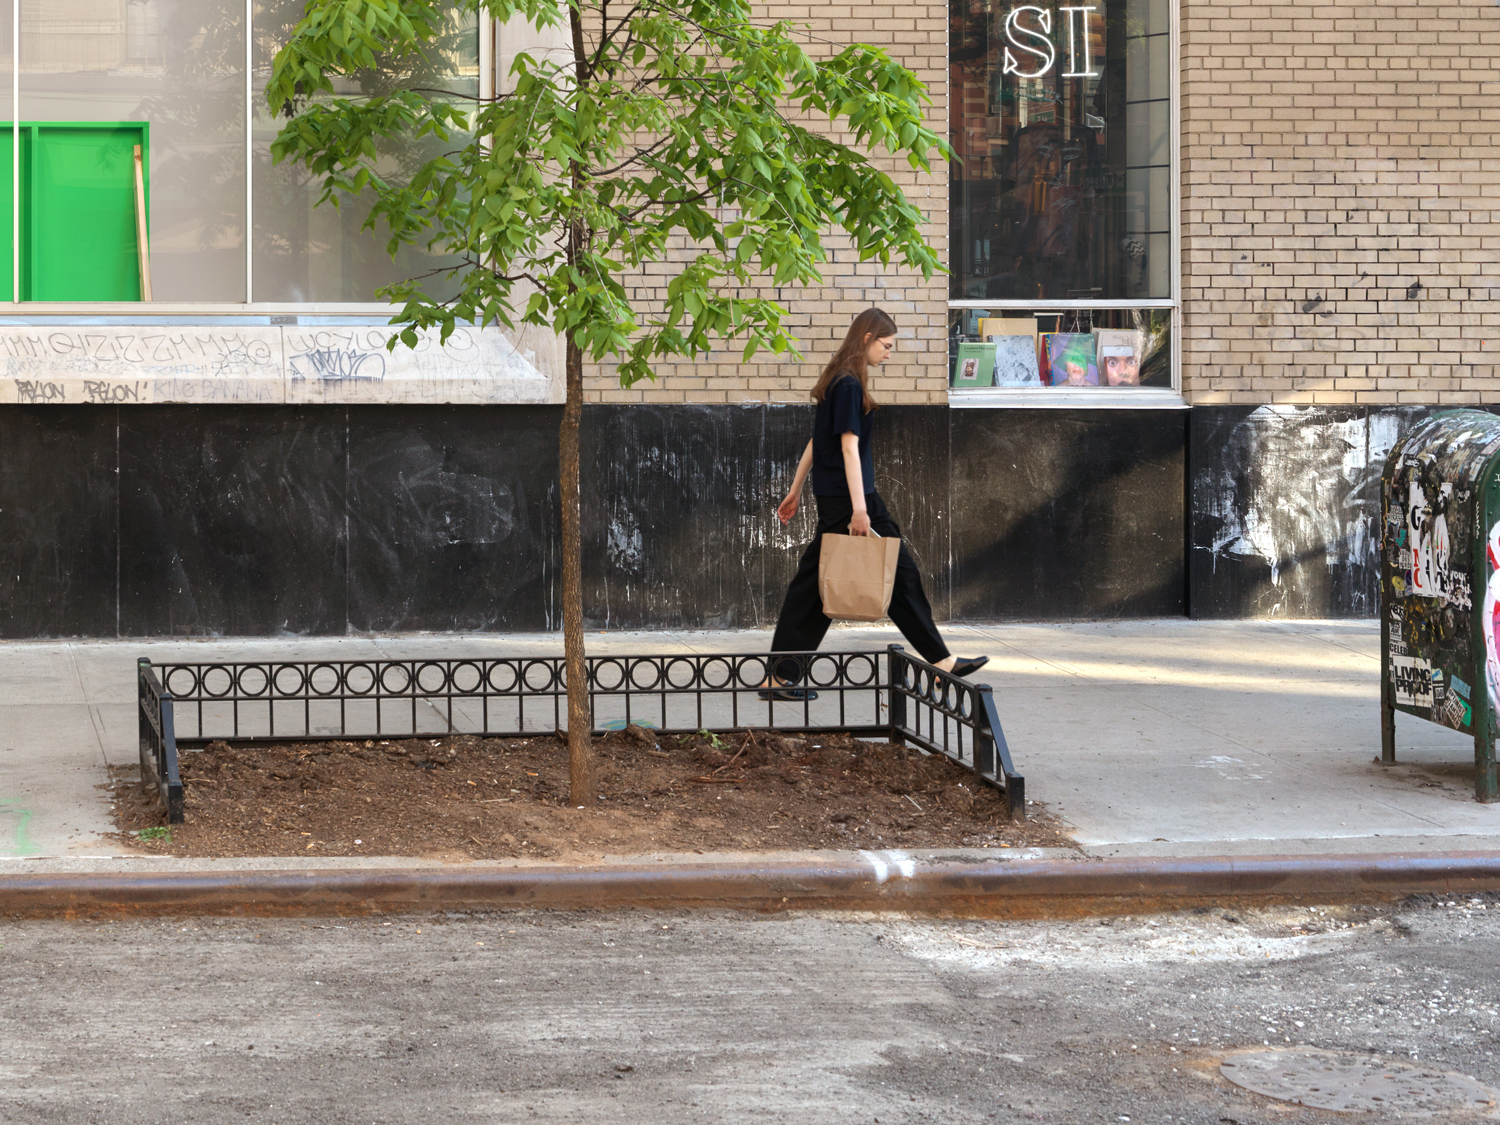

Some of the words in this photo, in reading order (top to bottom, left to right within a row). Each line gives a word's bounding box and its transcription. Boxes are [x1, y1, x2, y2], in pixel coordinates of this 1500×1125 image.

[1002, 5, 1099, 78] SI
[154, 378, 196, 398] KING
[200, 378, 273, 400] BANANA
[1394, 665, 1431, 682] LIVING
